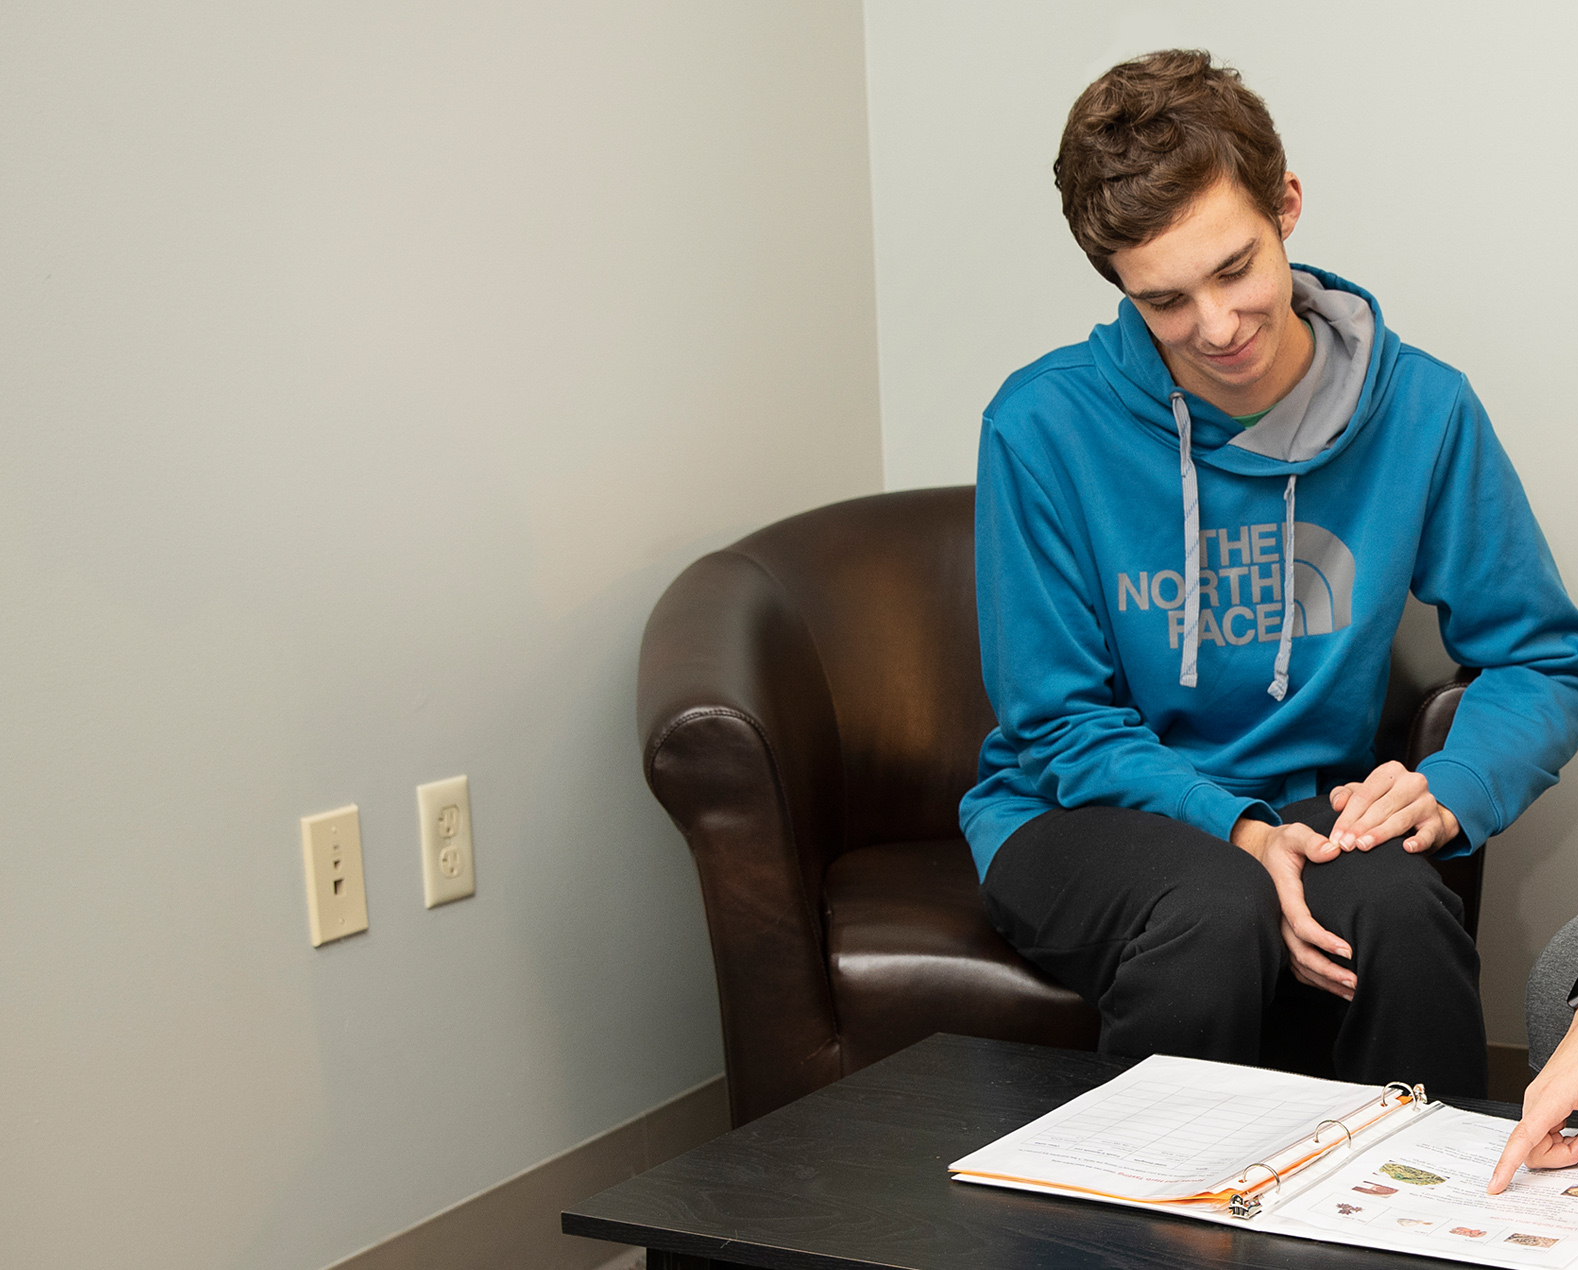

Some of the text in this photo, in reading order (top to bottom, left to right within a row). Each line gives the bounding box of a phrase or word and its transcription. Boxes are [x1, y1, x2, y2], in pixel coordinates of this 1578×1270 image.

[1199, 523, 1279, 568] THE
[1118, 563, 1282, 611] NORTH
[1168, 602, 1284, 649] FACE
